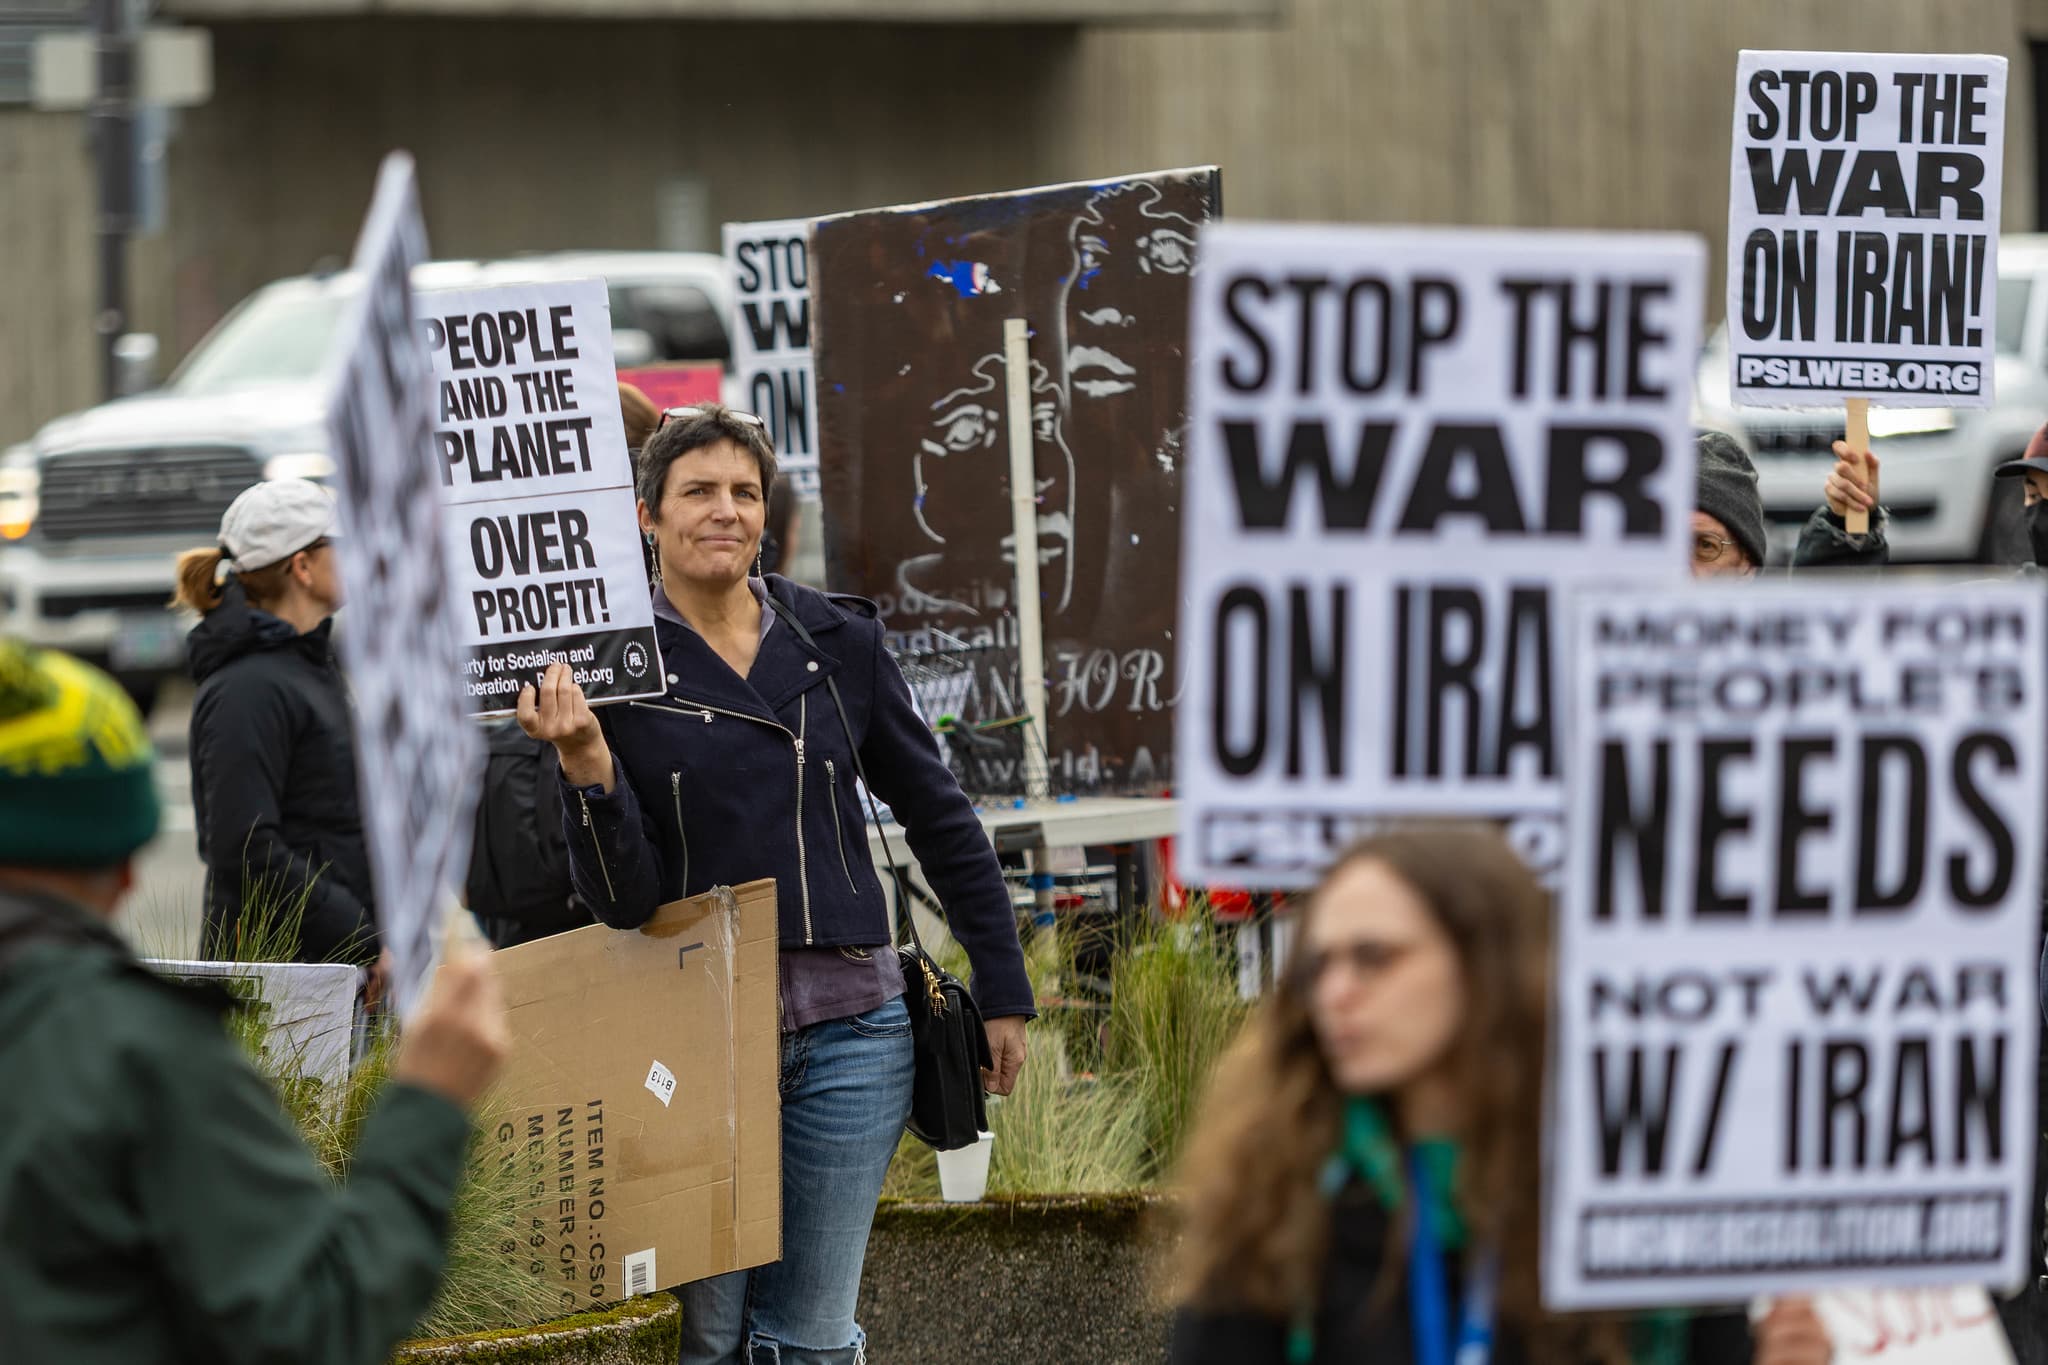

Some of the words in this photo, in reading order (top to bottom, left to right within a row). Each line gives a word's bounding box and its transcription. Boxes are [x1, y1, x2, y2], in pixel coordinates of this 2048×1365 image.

[1747, 69, 1878, 142] STOP
[1893, 72, 1989, 146] THE
[1745, 147, 1985, 221] WAR
[737, 238, 808, 294] STO
[1742, 227, 1818, 342] ON
[1835, 230, 1987, 348] IRAN!
[418, 305, 579, 372] PEOPLE
[1219, 273, 1463, 398] STOP
[1496, 279, 1671, 400] THE
[440, 375, 507, 422] AND
[513, 369, 578, 414] THE
[1740, 357, 1980, 392] PSLWEB.ORG
[434, 417, 592, 486] PLANET
[1217, 419, 1668, 541] WAR
[470, 508, 597, 580] OVER
[472, 577, 610, 635] PROFIT!
[1594, 609, 1857, 652] MONEY
[1881, 607, 2026, 648] FOR
[462, 659, 485, 678] arty
[488, 655, 506, 672] for
[507, 649, 568, 670] Socialism
[570, 644, 594, 663] and
[463, 678, 520, 697] iberation
[1212, 582, 1348, 780] ON
[1391, 583, 1564, 783] IRA
[1599, 664, 2025, 716] PEOPLE'S
[1593, 730, 2018, 924] NEEDS
[1588, 969, 1768, 1022] NOT
[1803, 965, 2007, 1017] WAR
[587, 1100, 604, 1170] ITEM
[1592, 1041, 1741, 1180] W/
[1784, 1035, 2009, 1173] IRAN
[557, 1107, 576, 1237] NUMBER
[559, 1243, 576, 1281] OF
